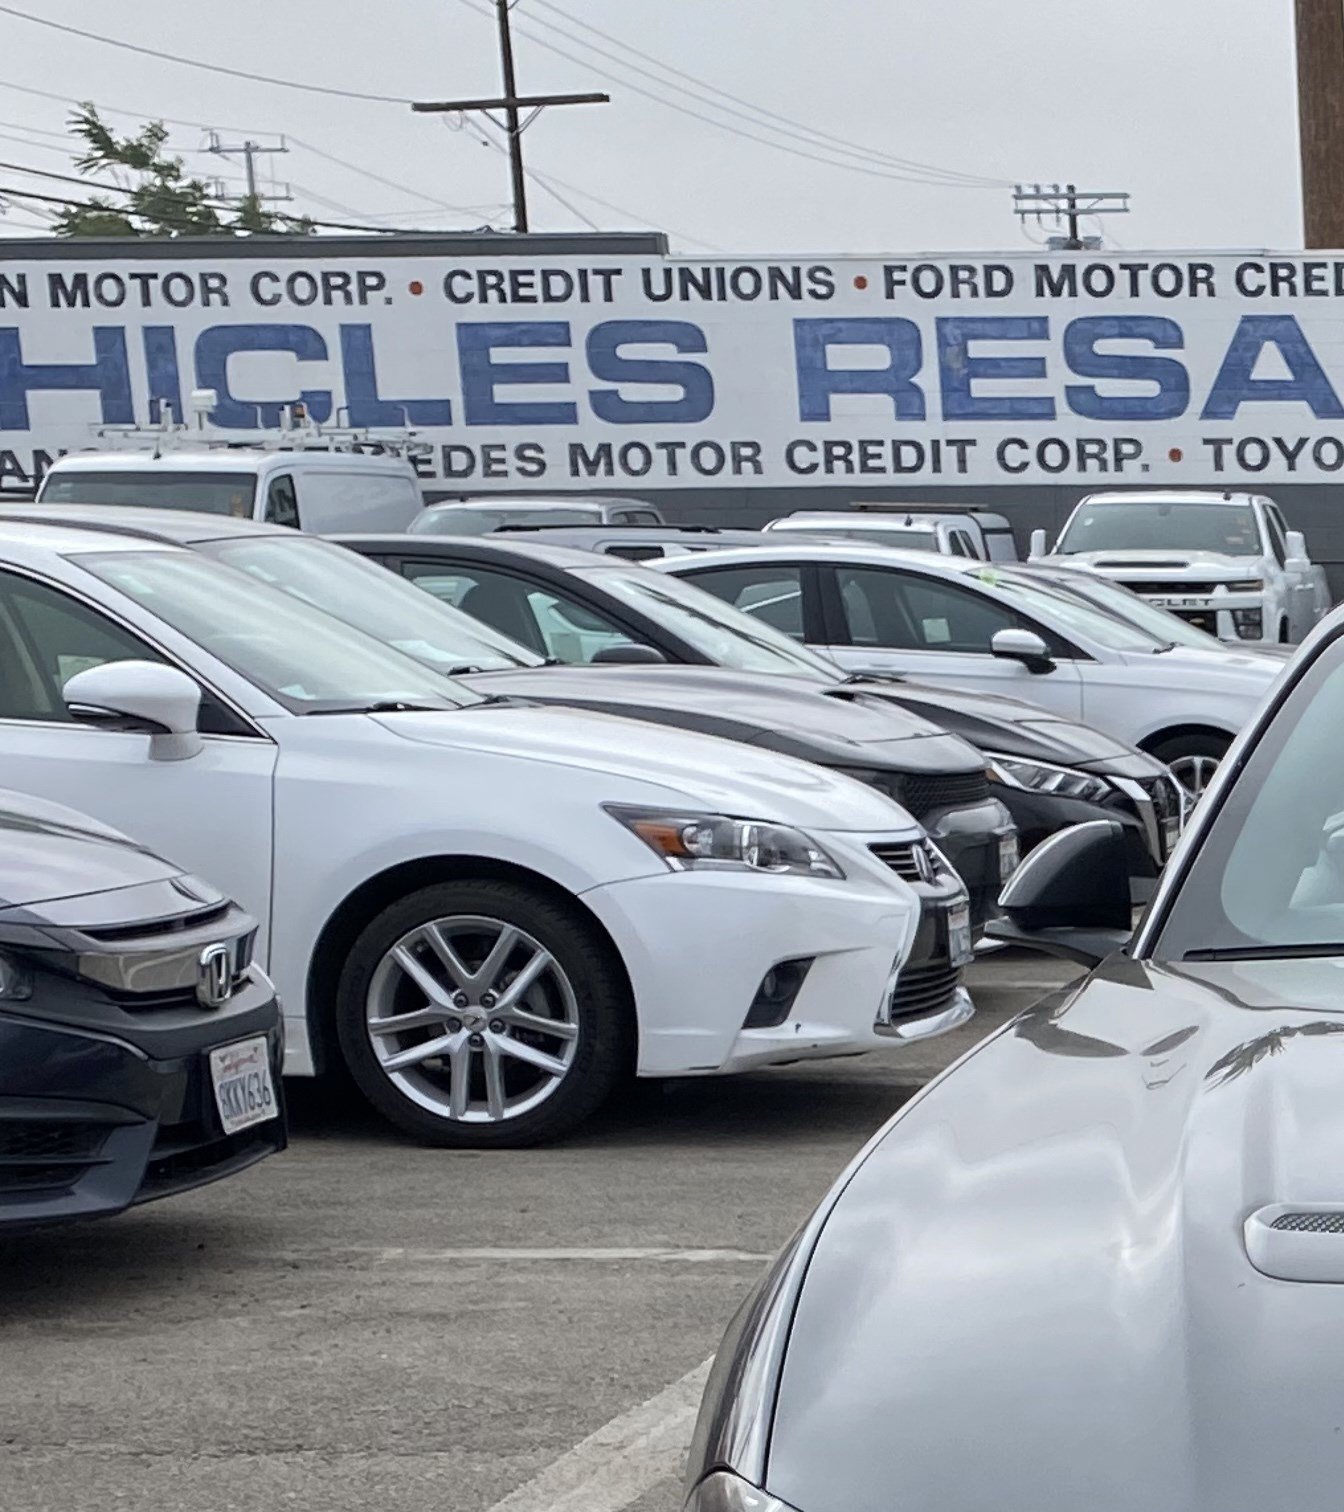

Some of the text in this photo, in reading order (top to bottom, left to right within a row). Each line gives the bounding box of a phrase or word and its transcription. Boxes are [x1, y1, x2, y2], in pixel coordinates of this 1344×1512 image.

[47, 272, 229, 308] MOTOR
[250, 270, 393, 306] CORP.
[443, 268, 622, 304] CREDIT
[641, 265, 836, 301] UNIONS
[883, 263, 1014, 299] FORD
[1034, 262, 1215, 298] MOTOR
[568, 439, 763, 477] MOTOR
[785, 438, 976, 475] CREDIT
[996, 437, 1150, 474] CORP.
